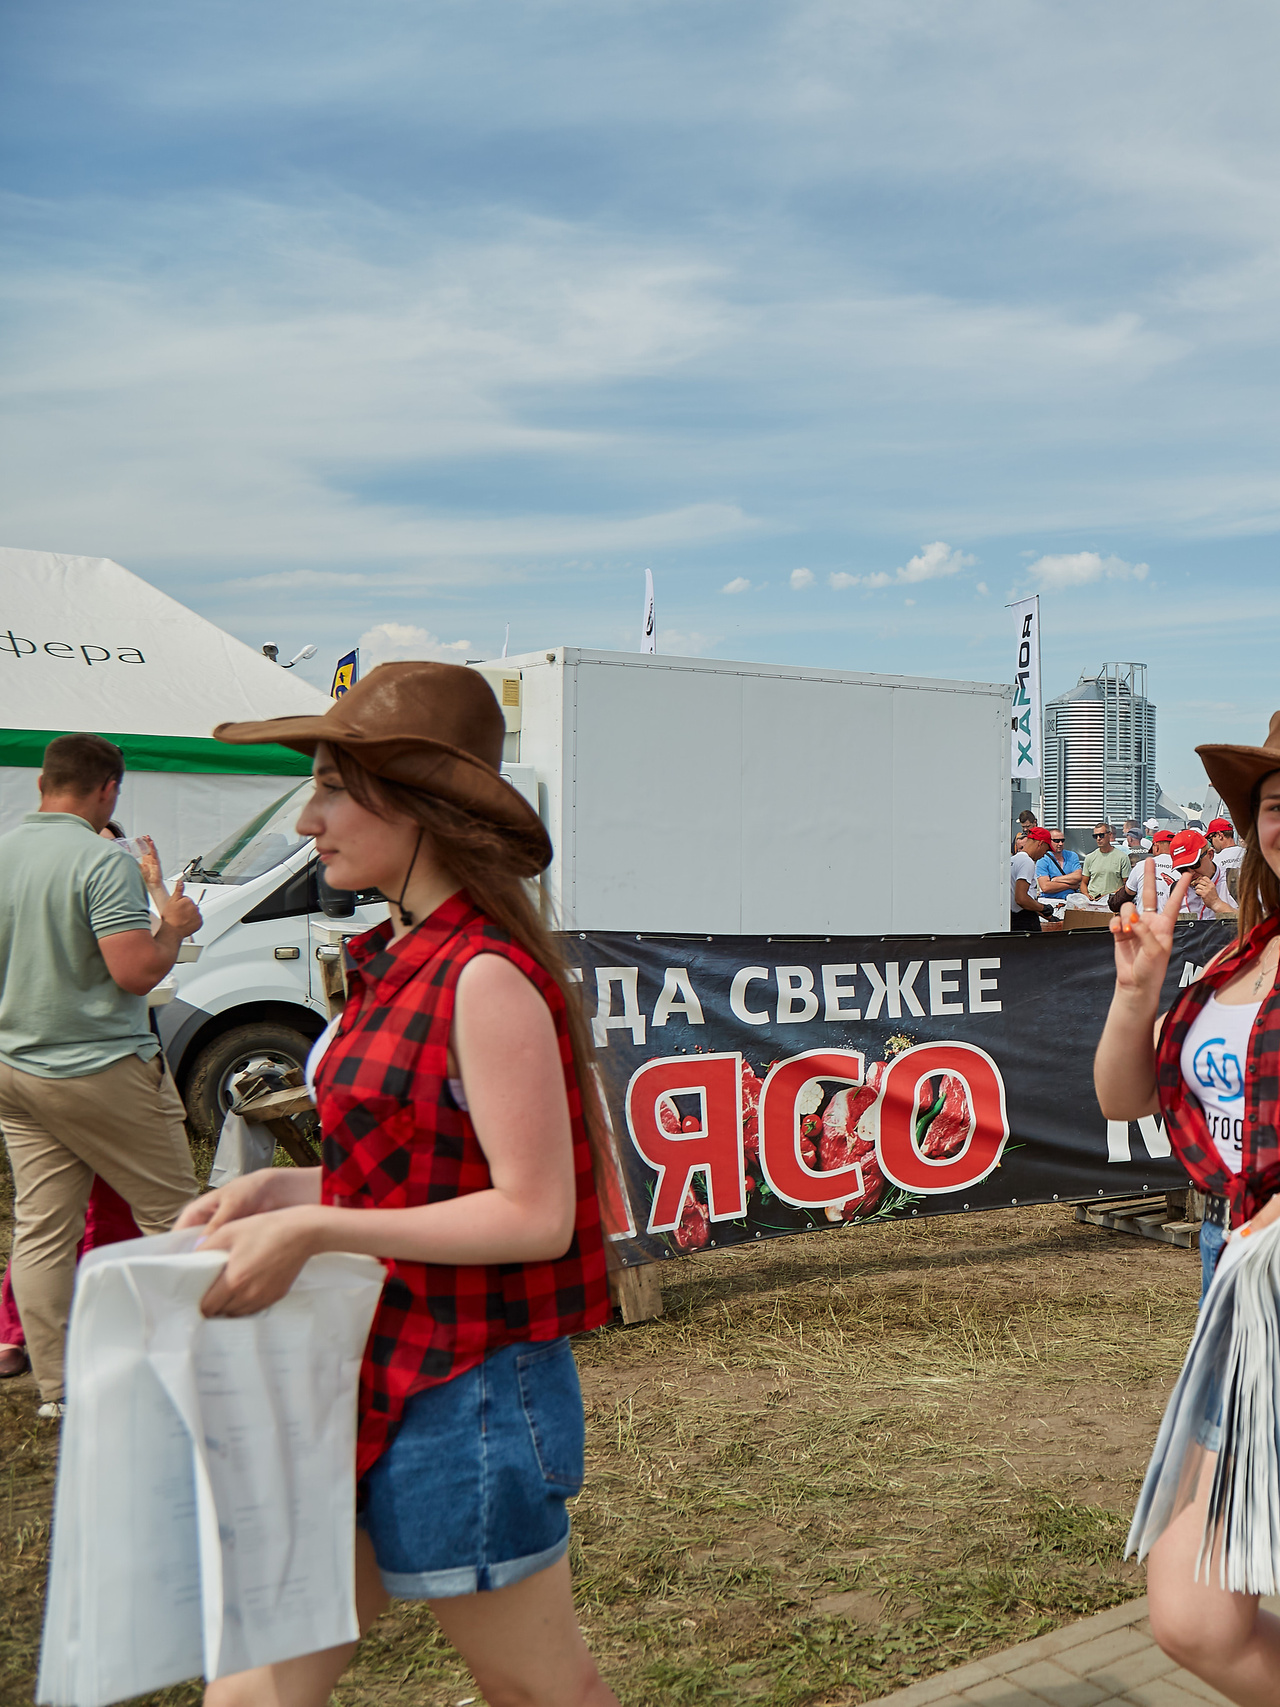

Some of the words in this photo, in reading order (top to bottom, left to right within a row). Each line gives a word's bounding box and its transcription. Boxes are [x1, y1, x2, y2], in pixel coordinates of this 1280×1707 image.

[0, 630, 146, 666] фера
[564, 966, 705, 1048] ДА
[728, 957, 1003, 1026] СВЕЖЕЕ
